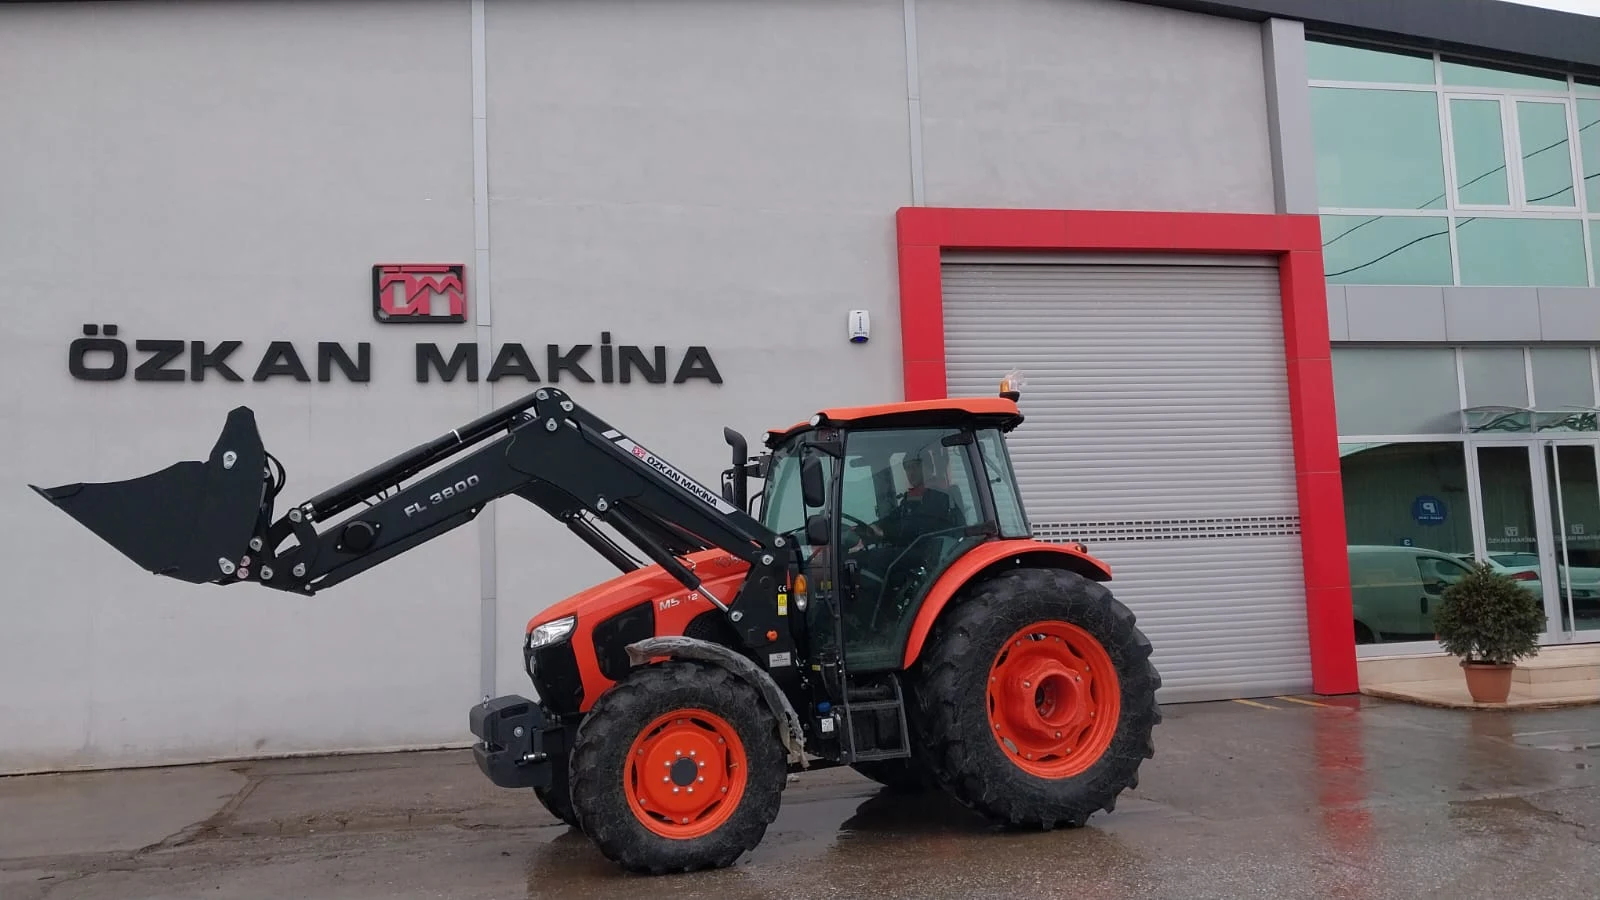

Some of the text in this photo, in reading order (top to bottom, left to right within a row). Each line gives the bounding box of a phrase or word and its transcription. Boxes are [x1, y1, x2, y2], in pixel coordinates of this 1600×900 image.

[69, 324, 723, 384] ÖZKAN MAKİNA
[403, 474, 479, 517] FL 3800
[646, 456, 718, 506] ÖZKAN MAKİNA
[659, 598, 681, 612] M5
